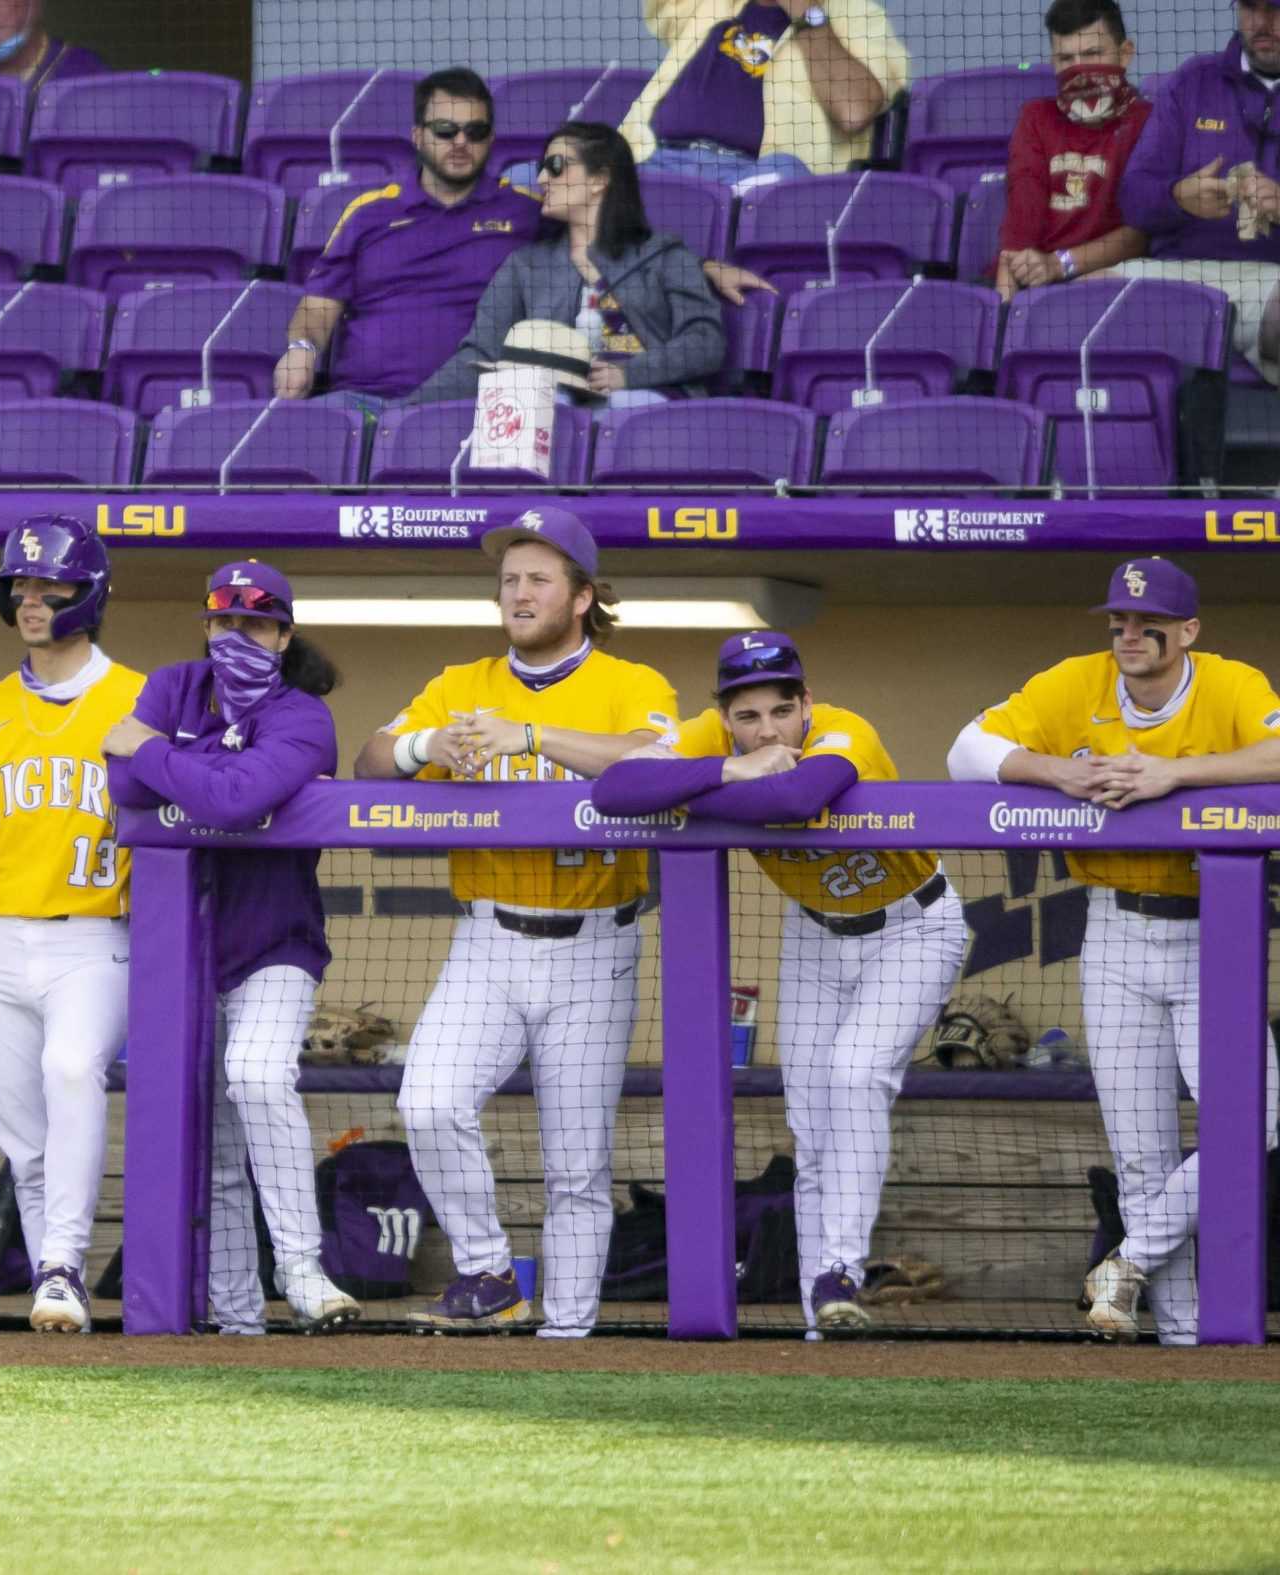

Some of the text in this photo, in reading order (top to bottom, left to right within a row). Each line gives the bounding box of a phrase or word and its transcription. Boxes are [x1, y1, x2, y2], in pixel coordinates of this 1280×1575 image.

[96, 504, 186, 536] LSU
[647, 507, 738, 540] LSU
[349, 804, 500, 832] LSUsports.net
[989, 801, 1107, 832] Community
[605, 830, 657, 839] COFFEE
[1021, 832, 1073, 840] COFFEE
[67, 836, 116, 887] 13
[821, 853, 887, 899] 22
